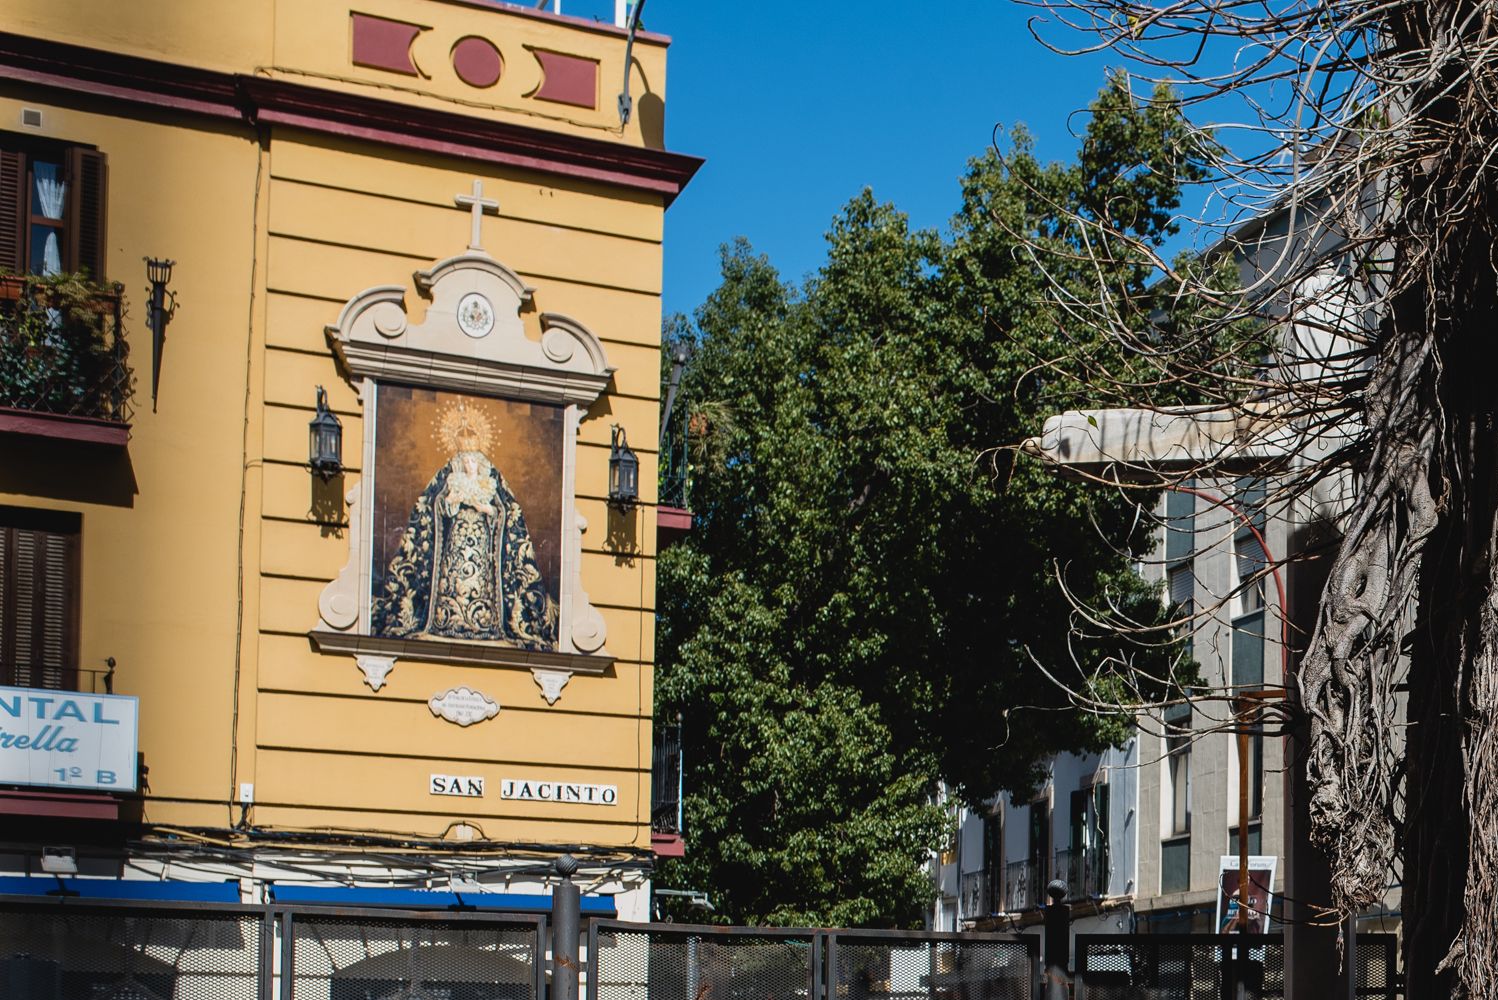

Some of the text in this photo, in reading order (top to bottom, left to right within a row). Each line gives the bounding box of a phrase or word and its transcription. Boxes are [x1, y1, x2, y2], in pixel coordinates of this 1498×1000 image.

[0, 725, 79, 752] rella
[96, 770, 117, 784] B
[433, 777, 616, 804] SAN JACINTO
